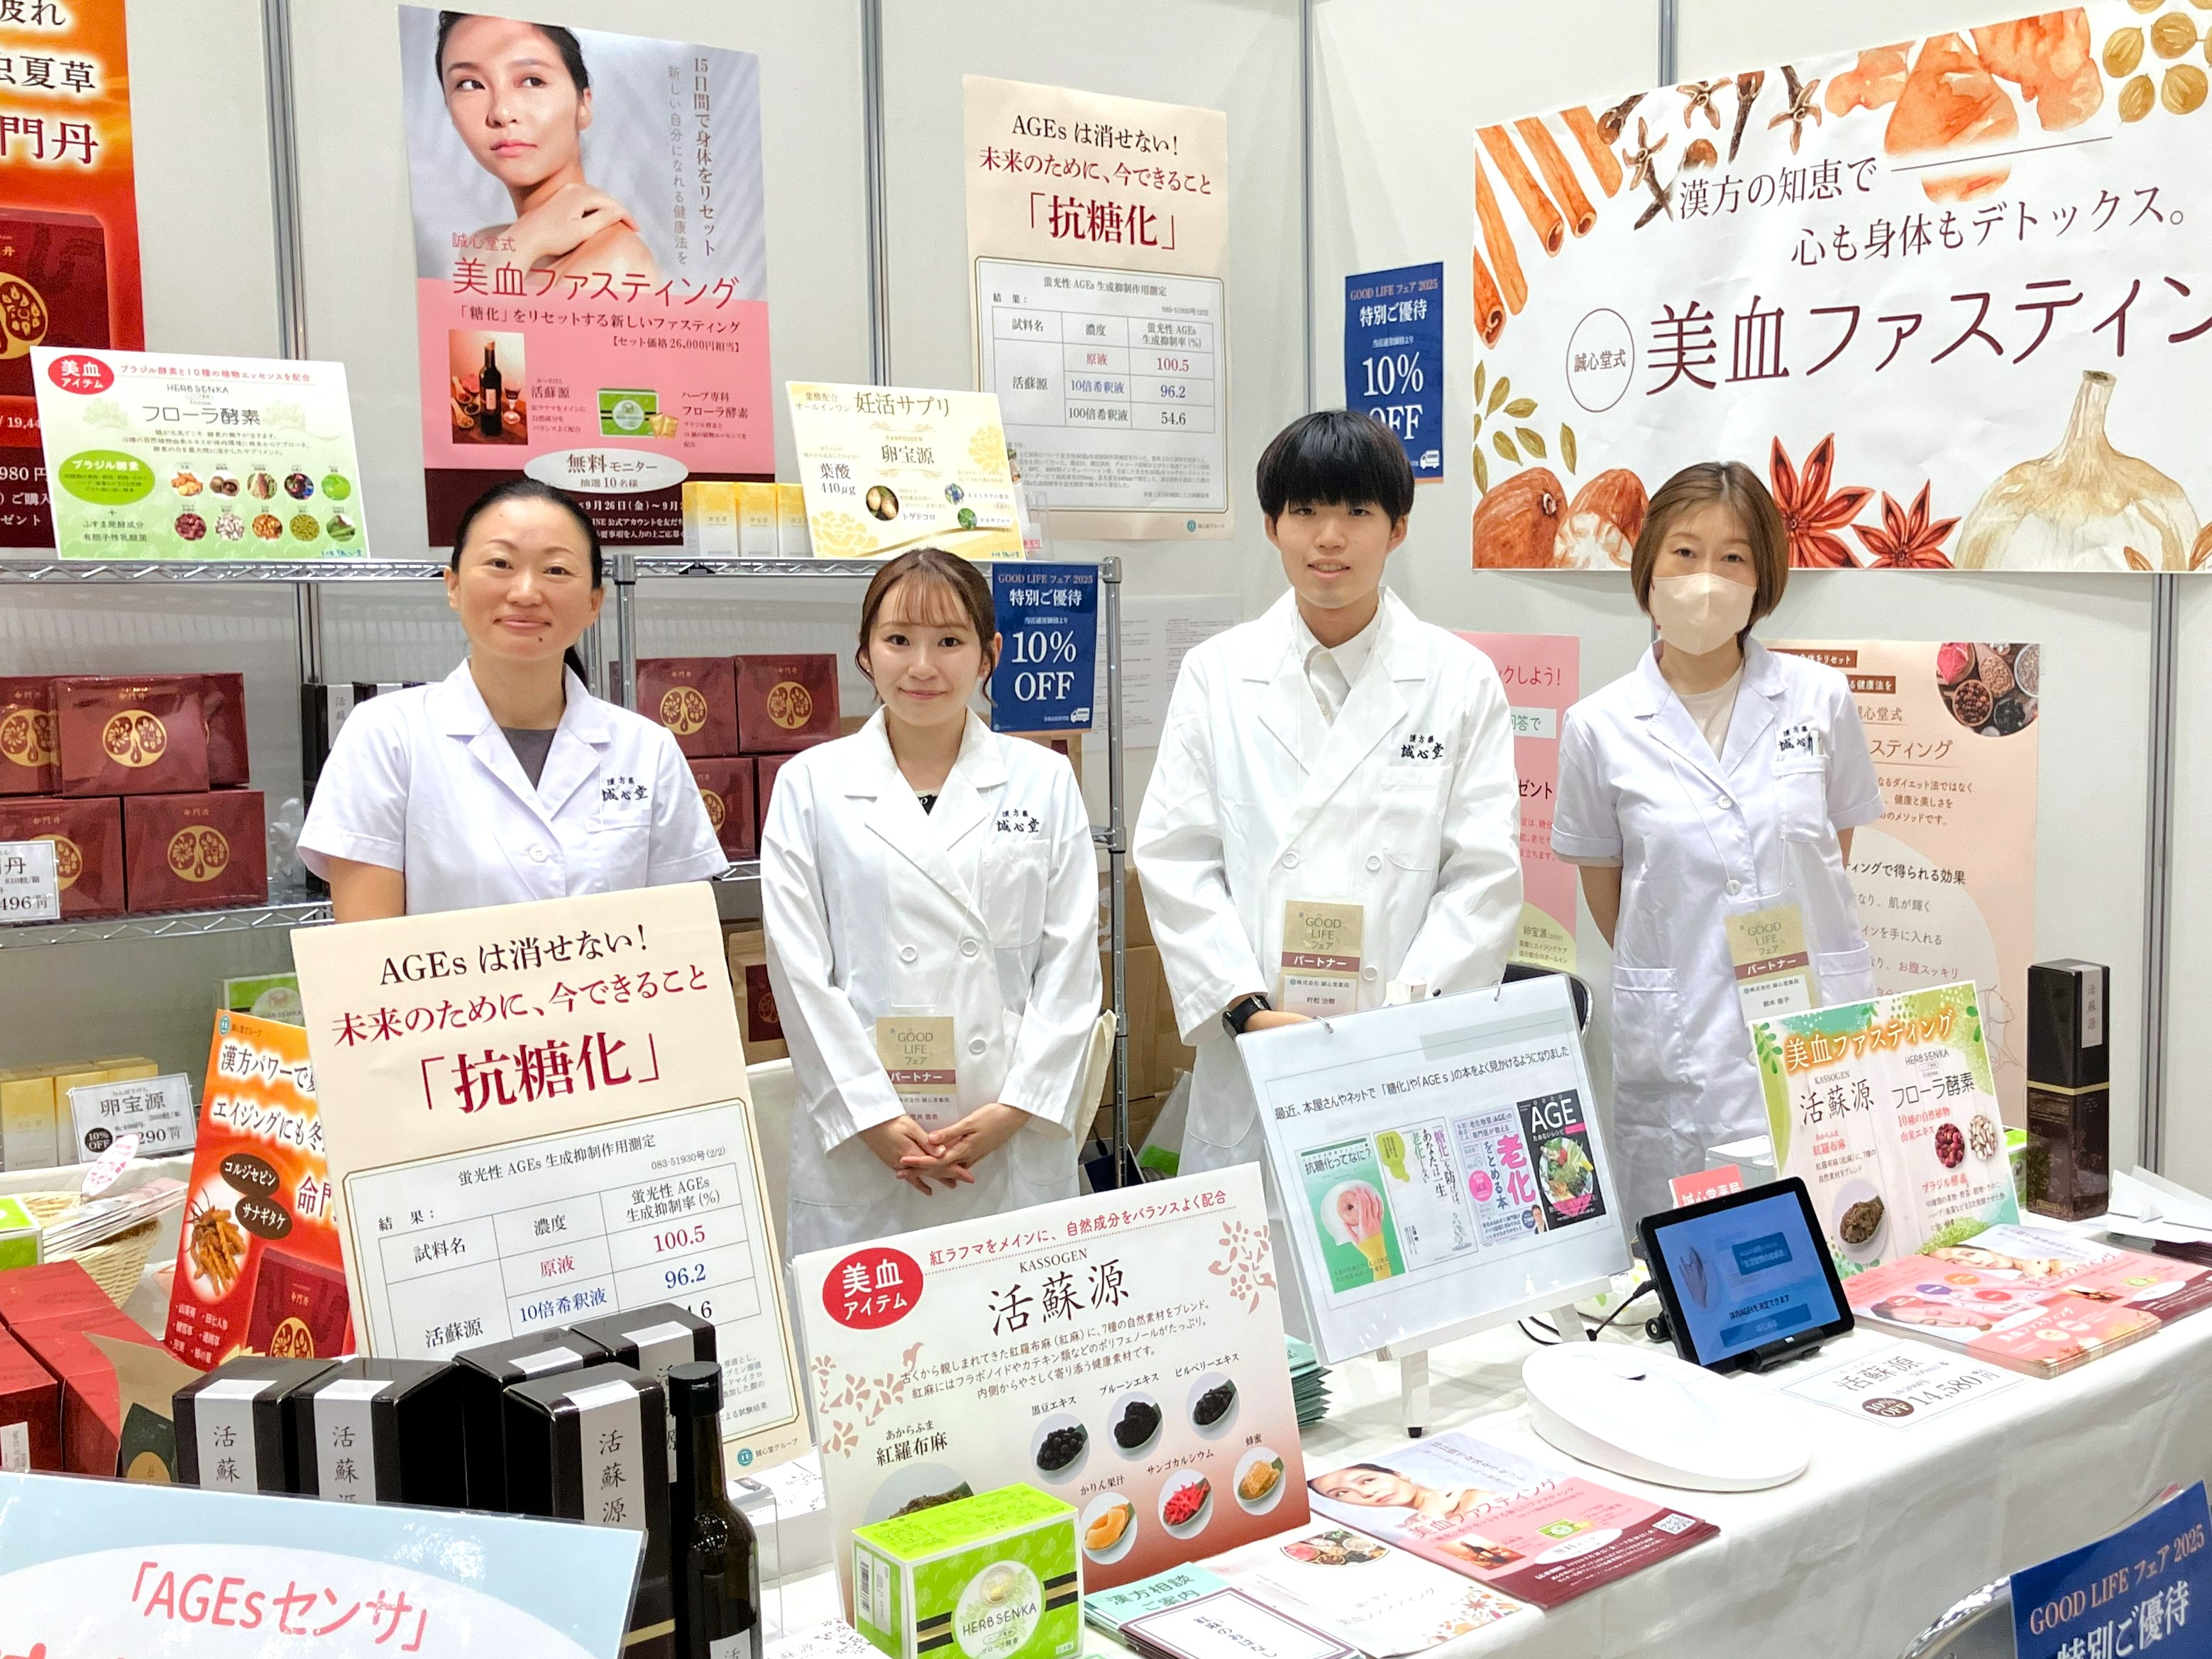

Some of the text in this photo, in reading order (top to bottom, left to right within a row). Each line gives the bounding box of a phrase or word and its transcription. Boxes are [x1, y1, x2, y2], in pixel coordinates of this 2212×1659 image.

[1012, 114, 1178, 156] AGEs は消せない!
[667, 65, 688, 265] 新しい自分になれる健康法を
[693, 57, 716, 257] 15日間で身体をリセット
[979, 146, 1212, 195] 未来のために、今できること
[1679, 156, 1878, 220] 漢方の知恵で
[1030, 192, 1176, 251] 「抗糖化」
[1791, 184, 2186, 268] 心も身体もデトックス。
[452, 232, 517, 253] 誠心堂式
[452, 257, 739, 310] 美血ファスティング
[1073, 279, 1095, 290] AGEs
[1350, 278, 1438, 301] GOOD LIFE フェア 2025
[460, 304, 742, 334] 「糖化」をリセットする新しいファスティング
[1359, 299, 1428, 327] 特別ご優待
[1011, 319, 1044, 332] 試料名
[1086, 324, 1106, 337] 濃度
[1174, 325, 1197, 336] AGEs
[1645, 275, 2212, 397] 美血ファスティン
[60, 360, 101, 378] 美血
[1086, 353, 1108, 366] 原液
[1157, 358, 1189, 373] 100.5
[1574, 348, 1627, 373] 誠心堂式
[61, 377, 104, 389] アイテム
[1012, 376, 1048, 391] 活蘇源
[1362, 351, 1424, 397] 10%
[166, 383, 229, 394] HERB SENKA
[531, 385, 570, 399] 活蘇源
[681, 391, 730, 402] ハーブ専科
[1070, 380, 1125, 395] 10倍希釈液
[1160, 385, 1186, 399] 96.2
[682, 405, 749, 419] フローラ酵素
[795, 402, 850, 413] オールインワン
[854, 391, 950, 417] 妊活サプリ
[1068, 407, 1129, 422] 100倍希釈液
[142, 405, 261, 426] フローラ酵素
[1160, 412, 1187, 426] 54.6
[72, 460, 140, 472] ブラジル酵素
[881, 445, 935, 465] 卵宝源
[818, 463, 851, 480] 葉酸
[580, 478, 638, 488] 抽選10名様
[902, 512, 935, 522] トゲドコロ
[998, 573, 1094, 584] GOOD LIFE フェア 2025
[1009, 588, 1082, 607] 特別ご優待
[1011, 630, 1077, 663] 10%
[1014, 671, 1075, 702] OFF
[1499, 665, 1561, 687] クしよう!
[1401, 742, 1444, 760] 誠心堂
[1869, 739, 1954, 760] スティング
[1306, 917, 1341, 928] GOOD
[1523, 925, 1548, 939] 卵宝源
[1747, 922, 1781, 937] GOOD
[1311, 929, 1334, 939] LIFE
[1756, 934, 1778, 946] LIFE
[1862, 925, 1942, 946] インを手に入れる
[380, 924, 647, 986] AGEs は消せない!
[1311, 941, 1334, 950] フェア
[1758, 944, 1778, 956] フェア
[1294, 955, 1346, 967] パートナー
[1746, 959, 1796, 976] パートナー
[331, 963, 708, 1048] 未来のために、今できること
[898, 1032, 933, 1042] GOOD
[1784, 1008, 1954, 1070] 美血ファスティング
[904, 1044, 927, 1054] LIFE
[1905, 1048, 1950, 1066] HERB SENKA
[905, 1057, 927, 1065] フェア
[422, 1032, 661, 1115] 「抗糖化」
[891, 1071, 942, 1082] パートナー
[1814, 1069, 1851, 1086] KASSOGEN
[1891, 1071, 1976, 1109] フローラ酵素
[100, 1091, 166, 1118] 卵宝源
[1799, 1079, 1875, 1126] 活蘇源
[1531, 1098, 1578, 1134] AGE
[1898, 1107, 1951, 1128] 10種の自然植物
[89, 1131, 110, 1142] 10%
[1532, 1129, 1565, 1142] ためないレシピ
[1900, 1125, 1935, 1142] 由来エキス
[88, 1140, 110, 1150] OFF
[507, 1133, 656, 1176] AGEs 生成抑制作用測定
[1812, 1140, 1847, 1157] 紅羅布麻
[1304, 1148, 1371, 1175] 抗糖化ってなに?
[1496, 1134, 1536, 1206] 老化
[224, 1161, 277, 1187] コルジセピン
[1484, 1141, 1509, 1211] をとめる本
[1818, 1165, 1863, 1184] 自然素材をブレンド
[1922, 1172, 1969, 1194] ブラジル酵素
[676, 1177, 711, 1195] AGEs
[242, 1203, 287, 1230] サナギタケ
[533, 1213, 567, 1236] 濃度
[413, 1237, 467, 1264] 試料名
[653, 1225, 707, 1255] 100.5
[539, 1255, 576, 1279] 原液
[1019, 1247, 1088, 1274] KASSOGEN
[664, 1263, 708, 1289] 96.2
[841, 1259, 903, 1299] 美血
[519, 1286, 608, 1325] 10倍希釈液
[843, 1294, 908, 1321] アイテム
[987, 1258, 1130, 1337] 活蘇源
[424, 1318, 484, 1350] 活蘇源
[911, 1318, 1208, 1401] 紅麻にはフラボノイドやカテキン類などのポリフェノールがたっぷり。
[1174, 1352, 1240, 1379] ビルベリーエキス
[976, 1347, 1156, 1401] 内側からやさしく寄り添う健康素材です。
[1831, 1355, 1925, 1391] 活蘇源
[1099, 1372, 1161, 1397] プルーンエキス
[1030, 1395, 1077, 1417] 黒豆エキス
[1865, 1397, 1898, 1412] 10%
[1880, 1402, 1911, 1417] OFF
[886, 1419, 935, 1442] あからふま
[1245, 1433, 1262, 1448] 蜂蜜
[755, 1438, 798, 1457] 誠心堂グループ
[876, 1431, 949, 1467] 紅羅布麻
[1146, 1448, 1215, 1477] サンゴカルシウム
[598, 1431, 628, 1524] 活蘇源
[1079, 1473, 1126, 1498] かりん果汁
[1407, 1477, 1556, 1539] 美血ファスティング
[1106, 1573, 1195, 1606] 漢方相談
[2029, 1523, 2206, 1636] GOOD LIFE フェア 2025
[131, 1558, 429, 1653] 「AGEsセンサ」
[1140, 1589, 1201, 1611] ご案内
[962, 1602, 1038, 1636] HERB SENKA
[2057, 1580, 2190, 1659] 特別ご優待
